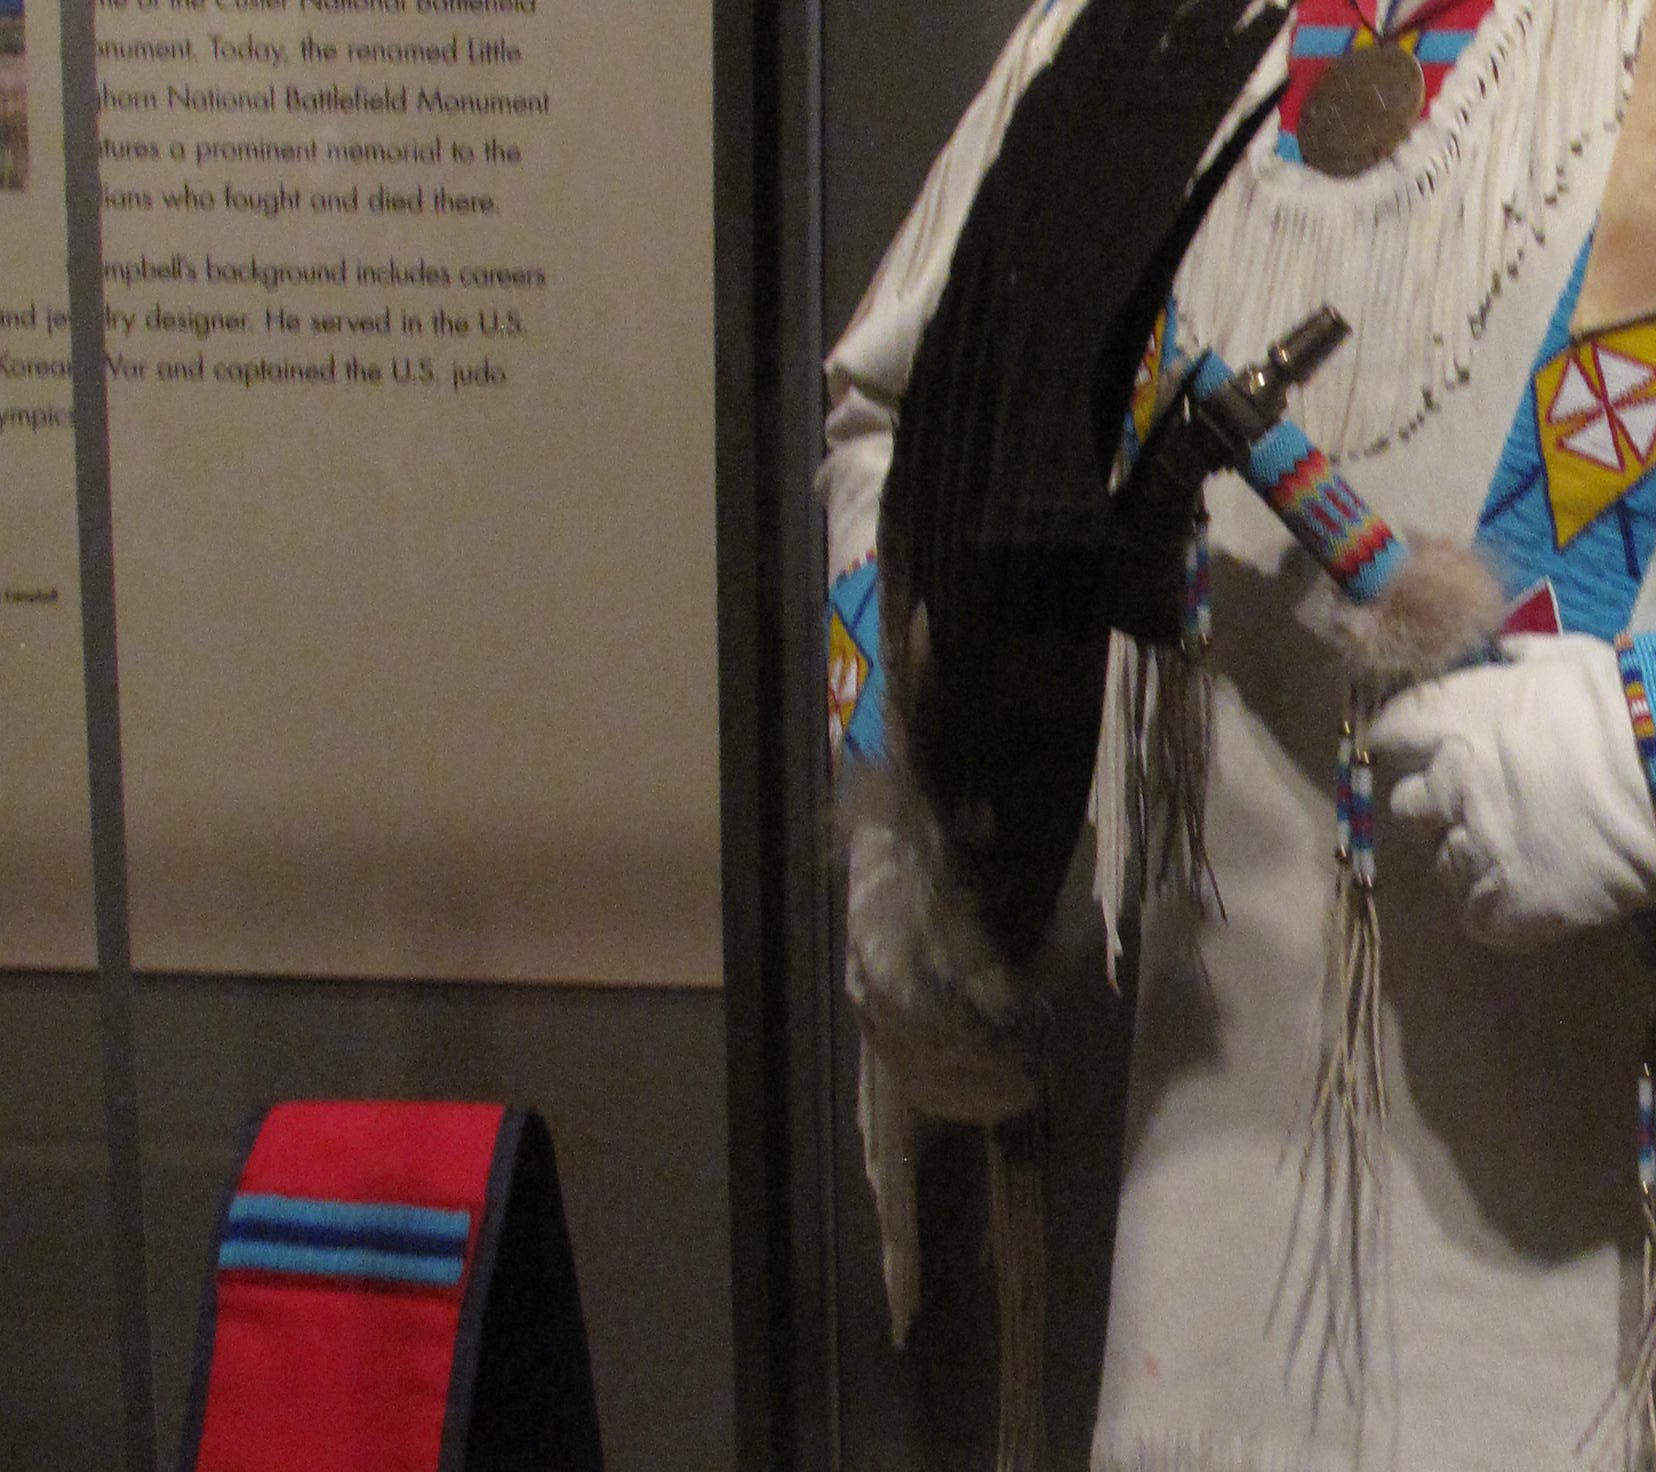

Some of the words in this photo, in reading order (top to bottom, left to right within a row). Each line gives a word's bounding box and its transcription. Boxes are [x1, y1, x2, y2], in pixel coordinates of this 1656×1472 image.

[301, 31, 337, 64] the
[348, 32, 458, 66] renamed
[467, 34, 522, 66] Little
[166, 81, 275, 113] National
[285, 81, 407, 115] Battlefield
[416, 85, 551, 116] Monument
[168, 141, 186, 162] a
[196, 135, 317, 170] prominent
[327, 135, 441, 165] memorial
[451, 139, 475, 165] to
[484, 135, 522, 166] the
[161, 178, 215, 213] who
[224, 179, 302, 218] fought
[310, 183, 358, 215] and
[368, 183, 423, 215] died
[205, 252, 348, 292] background
[356, 255, 452, 289] includes
[460, 265, 547, 289] careers
[265, 306, 301, 336] He
[311, 304, 392, 337] served
[402, 308, 424, 336] in
[433, 304, 470, 338] the
[157, 351, 204, 382] and
[214, 353, 336, 390] captained
[346, 354, 383, 384] the
[454, 356, 507, 393] judo
